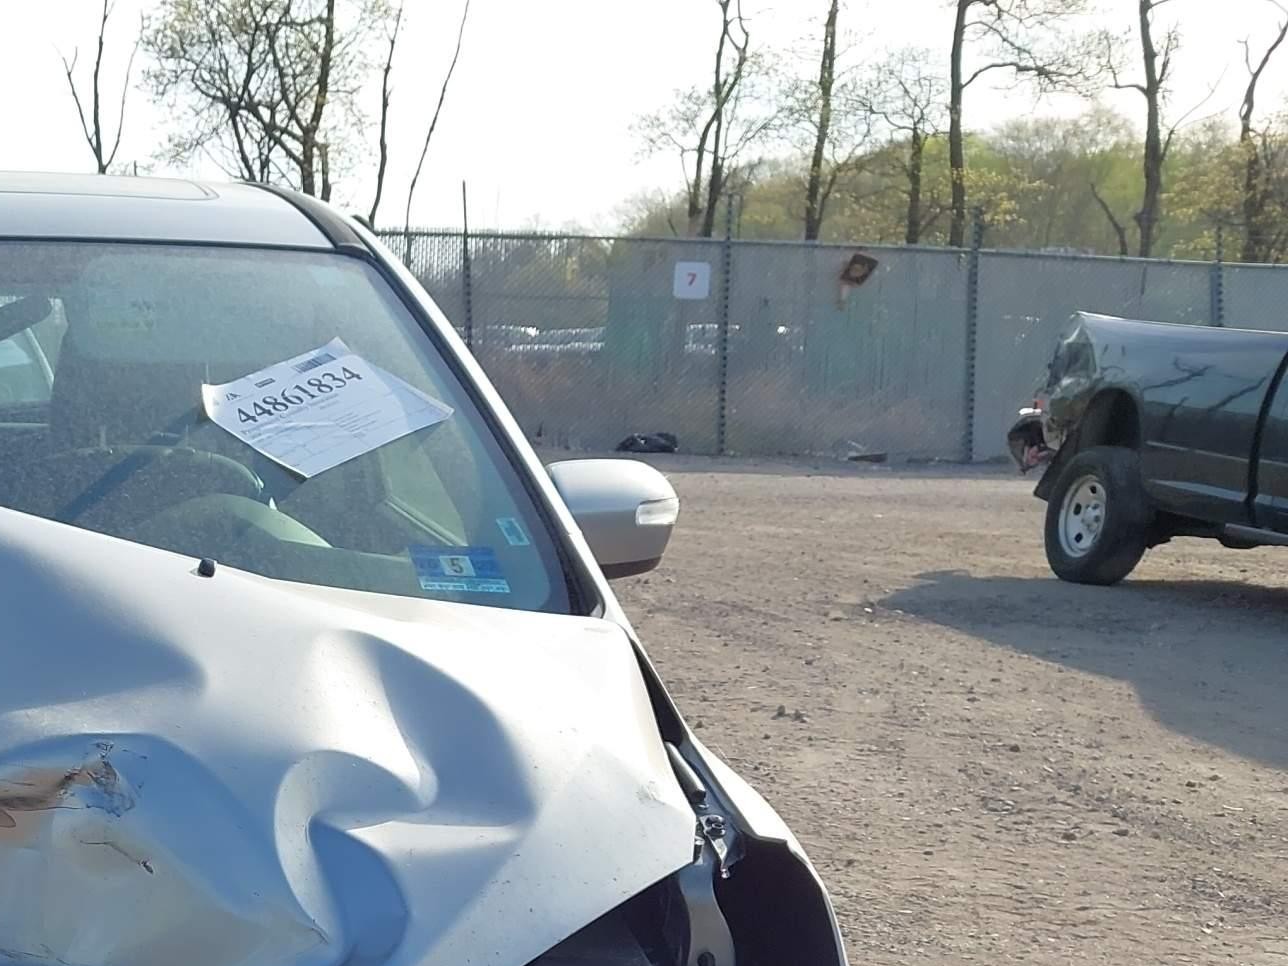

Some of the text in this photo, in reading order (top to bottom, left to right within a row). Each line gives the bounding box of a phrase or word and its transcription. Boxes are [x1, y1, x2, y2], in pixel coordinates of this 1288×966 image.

[687, 272, 698, 287] 7
[237, 366, 363, 426] 44861834
[449, 557, 465, 574] 5
